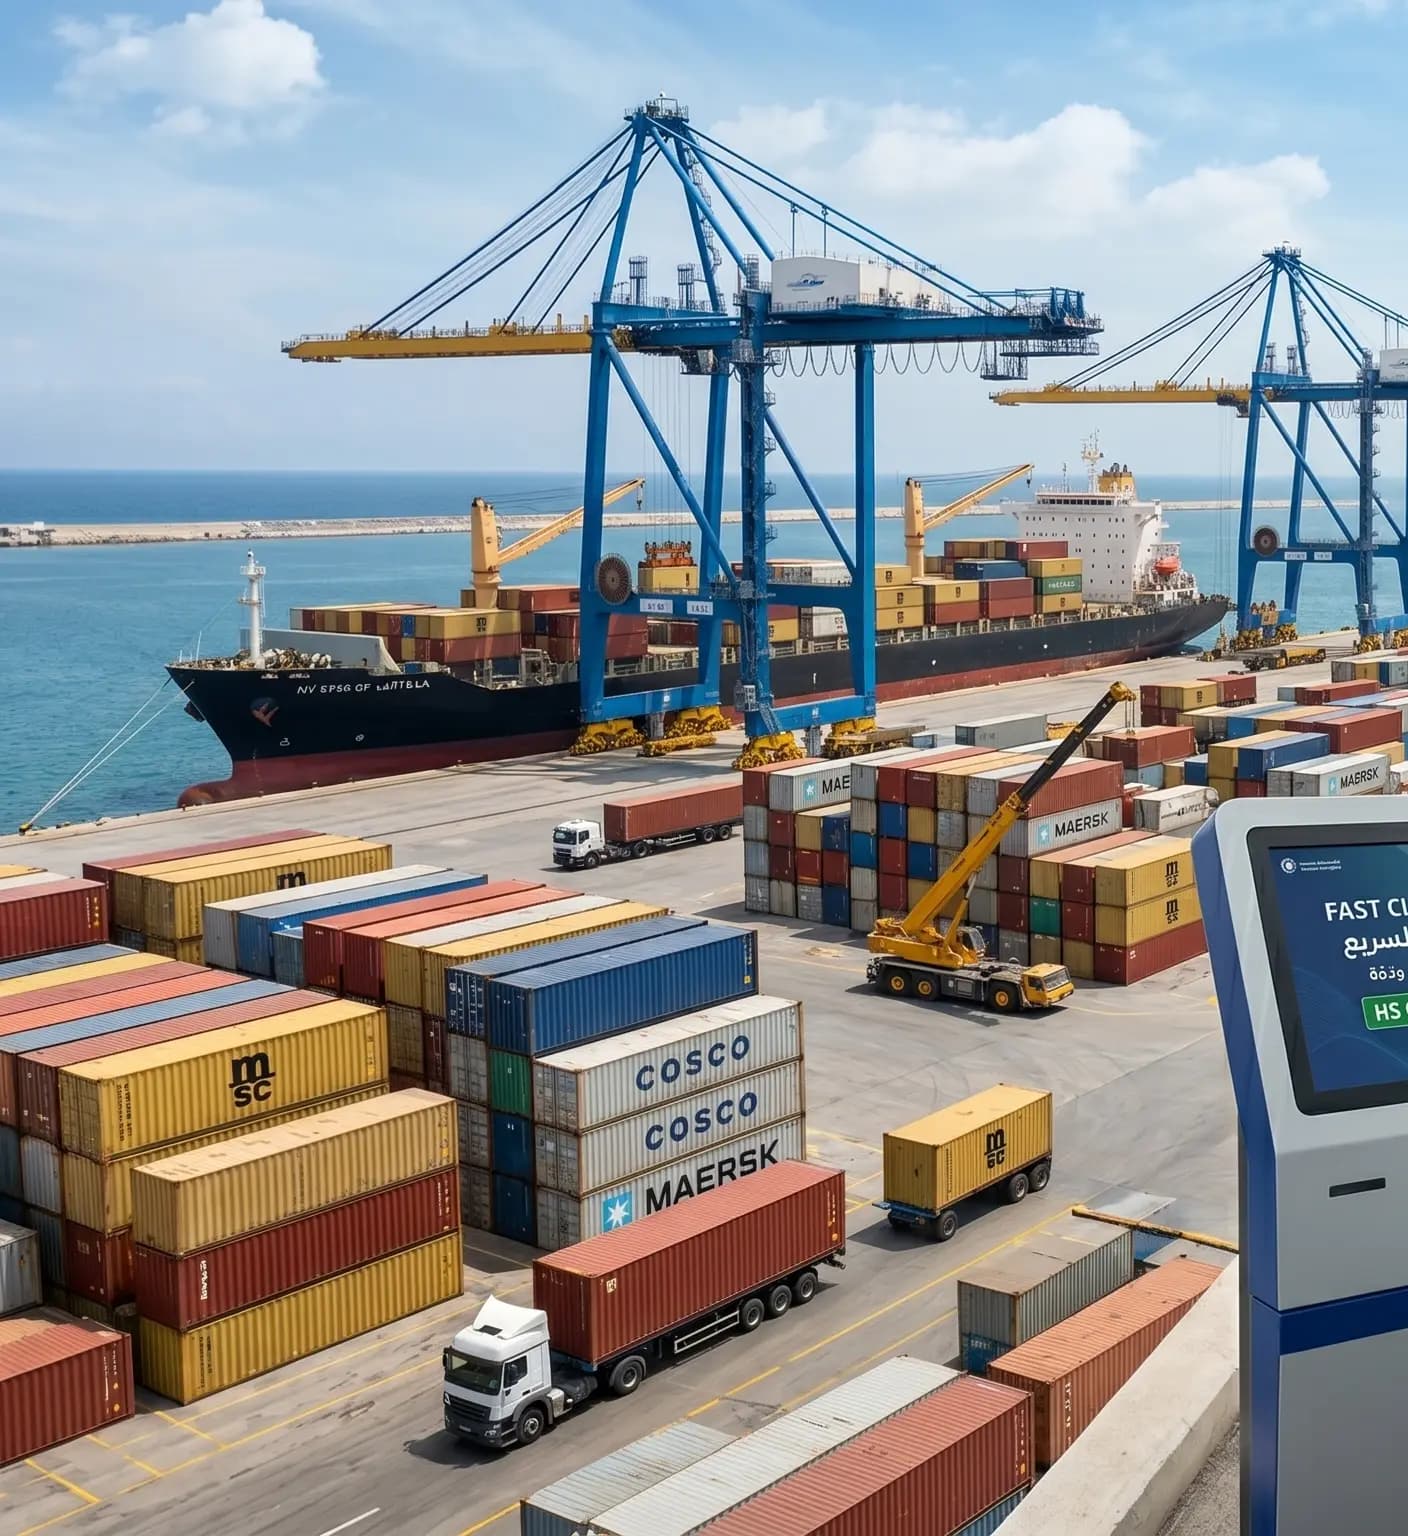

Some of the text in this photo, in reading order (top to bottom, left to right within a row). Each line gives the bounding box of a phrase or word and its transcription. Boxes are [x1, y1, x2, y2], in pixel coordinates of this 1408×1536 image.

[1055, 811, 1108, 838] MAERSK
[1324, 899, 1380, 921] FAST
[1374, 1002, 1401, 1022] HS
[636, 1035, 750, 1091] COSCO
[645, 1092, 757, 1150] COSCO
[646, 1139, 779, 1215] MAERSK
